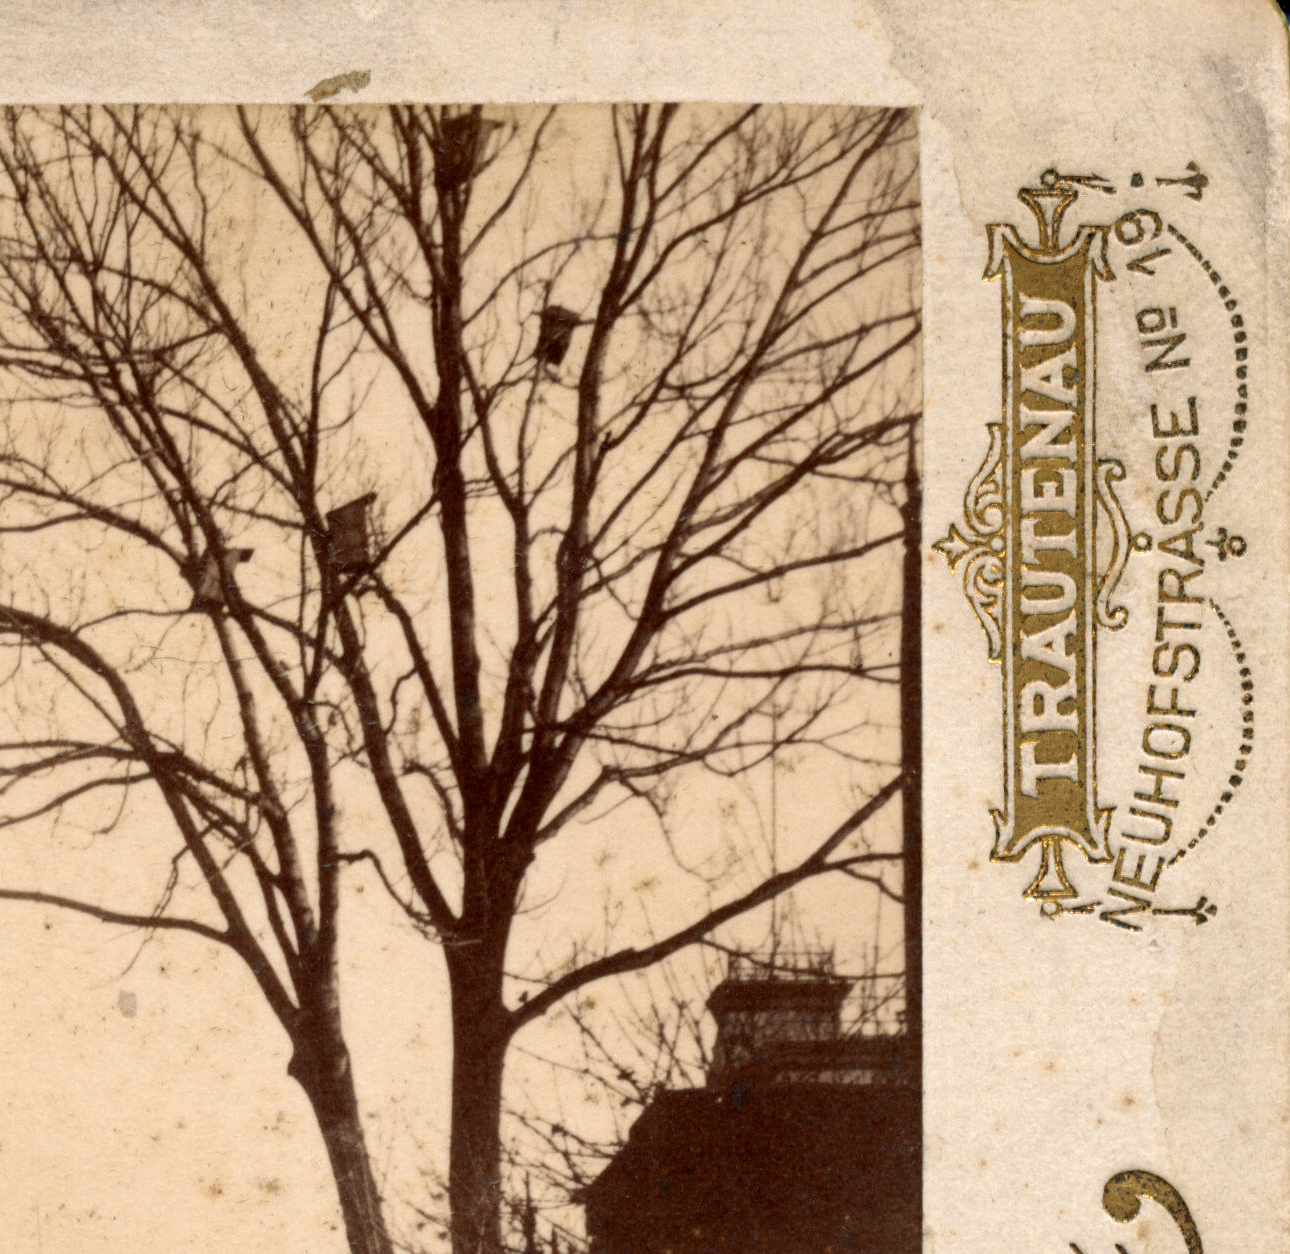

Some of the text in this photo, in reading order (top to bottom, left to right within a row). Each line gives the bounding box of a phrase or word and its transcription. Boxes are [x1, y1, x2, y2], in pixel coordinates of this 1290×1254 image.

[1114, 208, 1173, 276] 19
[1019, 294, 1080, 798] TRAUTENAU
[1100, 396, 1205, 932] NEUHOFSTRASSE
